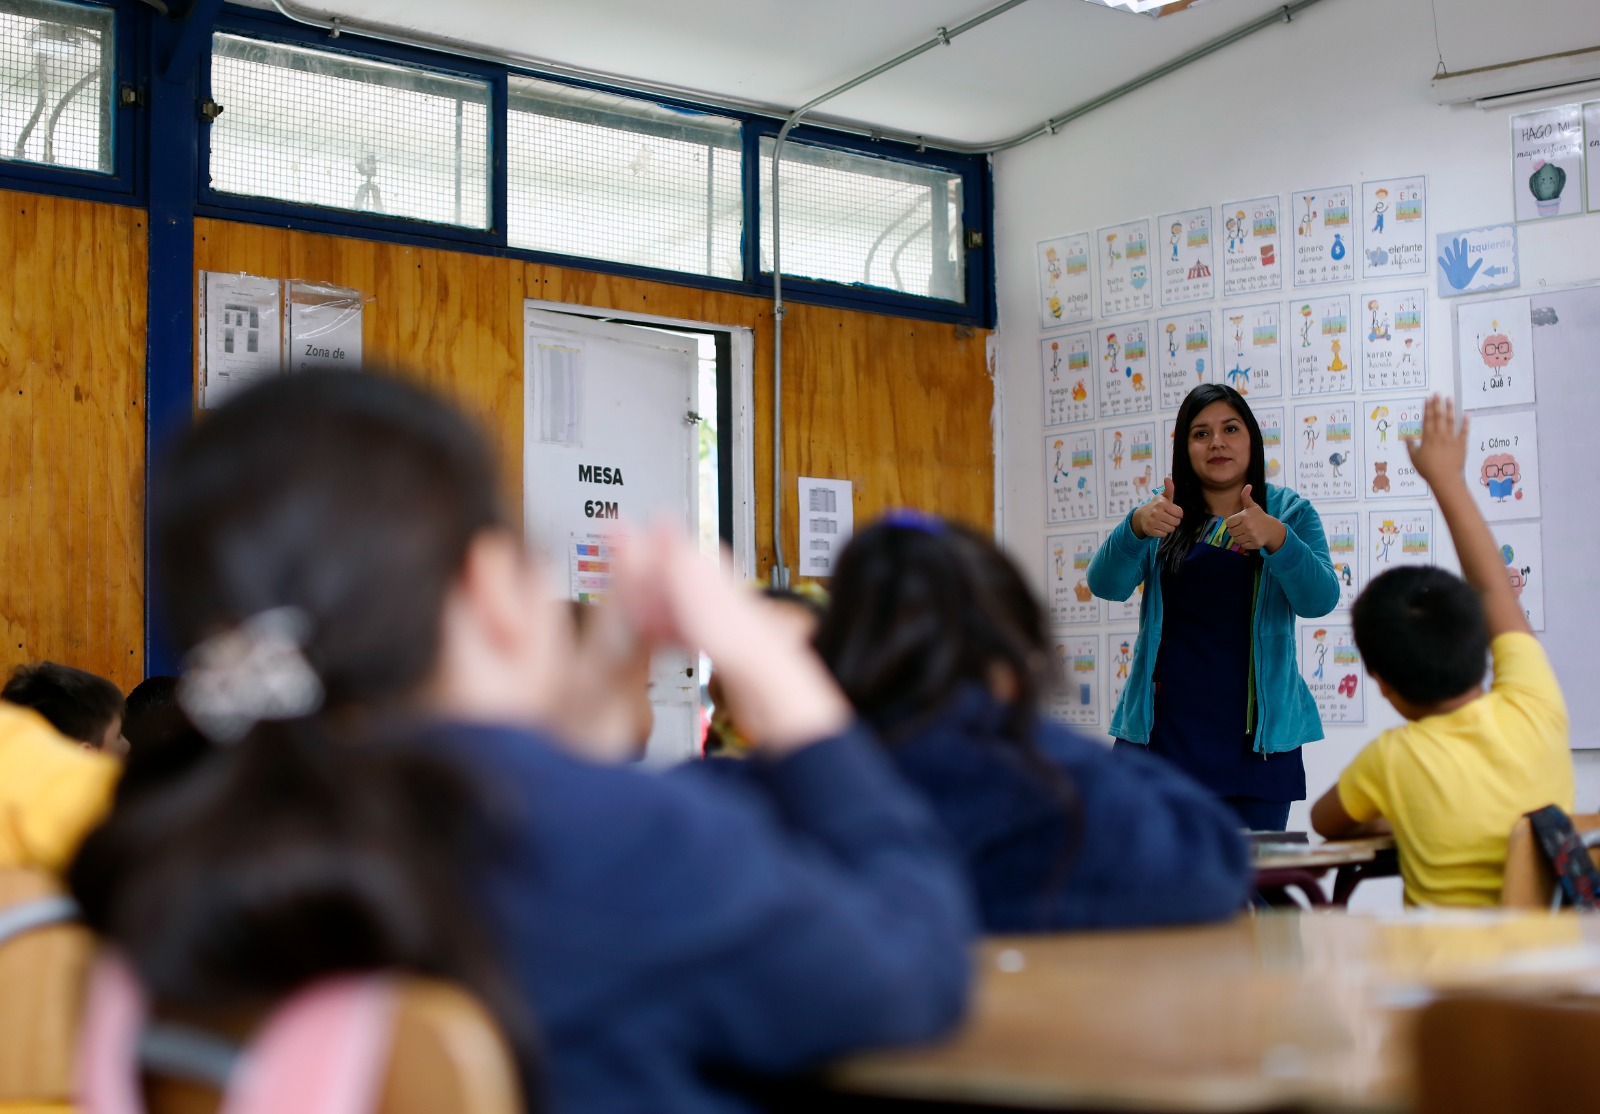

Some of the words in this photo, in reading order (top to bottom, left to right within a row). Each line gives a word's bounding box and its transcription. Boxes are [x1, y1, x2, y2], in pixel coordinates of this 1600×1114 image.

[1522, 124, 1552, 141] HAGO
[1558, 122, 1569, 131] MI
[1517, 149, 1540, 160] mayor
[1400, 192, 1405, 200] E
[1328, 200, 1334, 208] D
[1341, 198, 1345, 206] d
[1255, 211, 1263, 219] Ch
[1266, 209, 1275, 217] ch
[1299, 245, 1323, 254] dinero
[1388, 243, 1422, 254] elefante
[1469, 240, 1511, 253] Izquierda
[1227, 256, 1257, 264] chocolate
[1167, 267, 1184, 276] circo
[1068, 293, 1088, 303] abeja
[1413, 302, 1416, 310] k
[305, 344, 329, 357] Zona
[333, 348, 344, 359] de
[1298, 355, 1317, 365] jirafa
[1164, 370, 1186, 378] helado
[1254, 369, 1269, 377] isla
[1107, 380, 1121, 388] gato
[1490, 377, 1503, 388] Qué
[1050, 388, 1068, 396] fuego
[1401, 412, 1407, 420] O
[1488, 438, 1511, 448] Cómo
[578, 464, 624, 485] MESA
[584, 500, 618, 520] 62M
[1406, 524, 1412, 532] U
